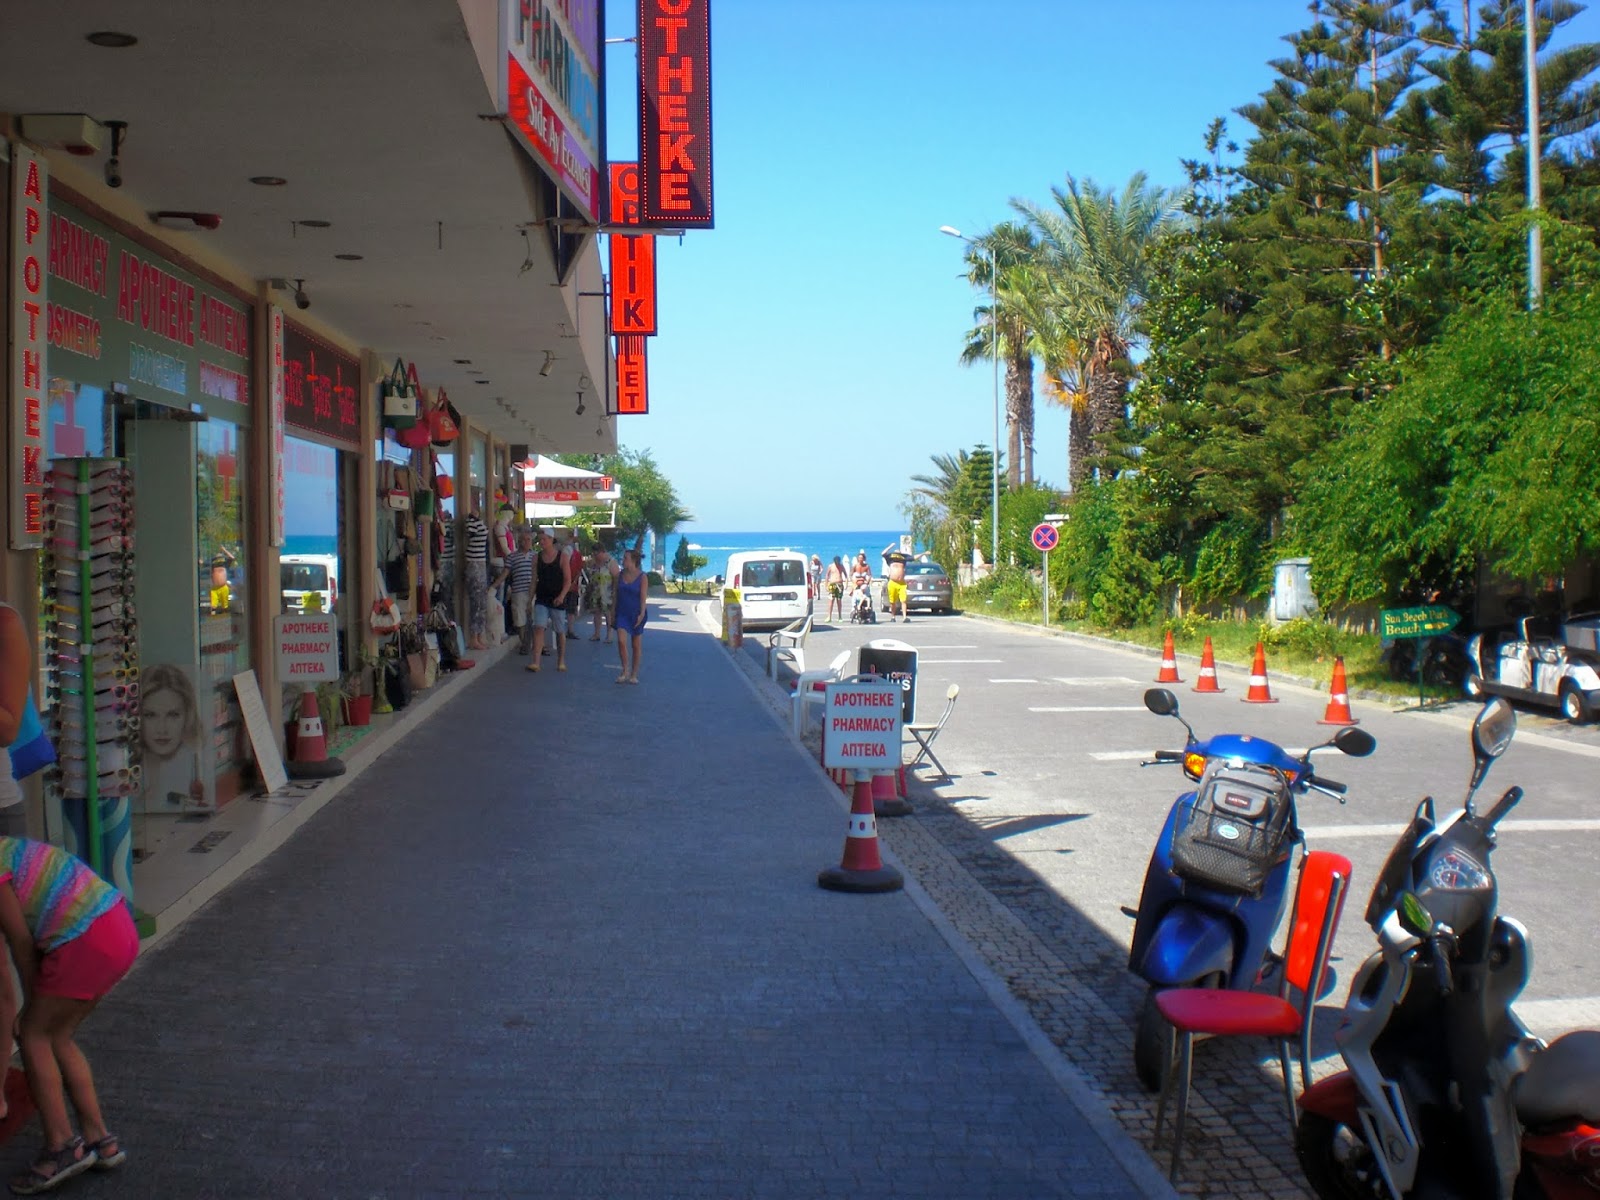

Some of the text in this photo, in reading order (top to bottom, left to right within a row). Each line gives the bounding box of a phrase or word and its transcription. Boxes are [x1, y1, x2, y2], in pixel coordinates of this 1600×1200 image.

[47, 210, 195, 348] ARMACY APOTHEKE
[23, 160, 42, 534] APOTHEKE
[540, 477, 612, 491] MARKET
[282, 622, 329, 634] APOTHEKE
[1385, 622, 1421, 636] Beach
[282, 642, 331, 655] PHARMACY
[834, 692, 894, 707] APOTHEKE
[833, 717, 896, 732] PHARMACY
